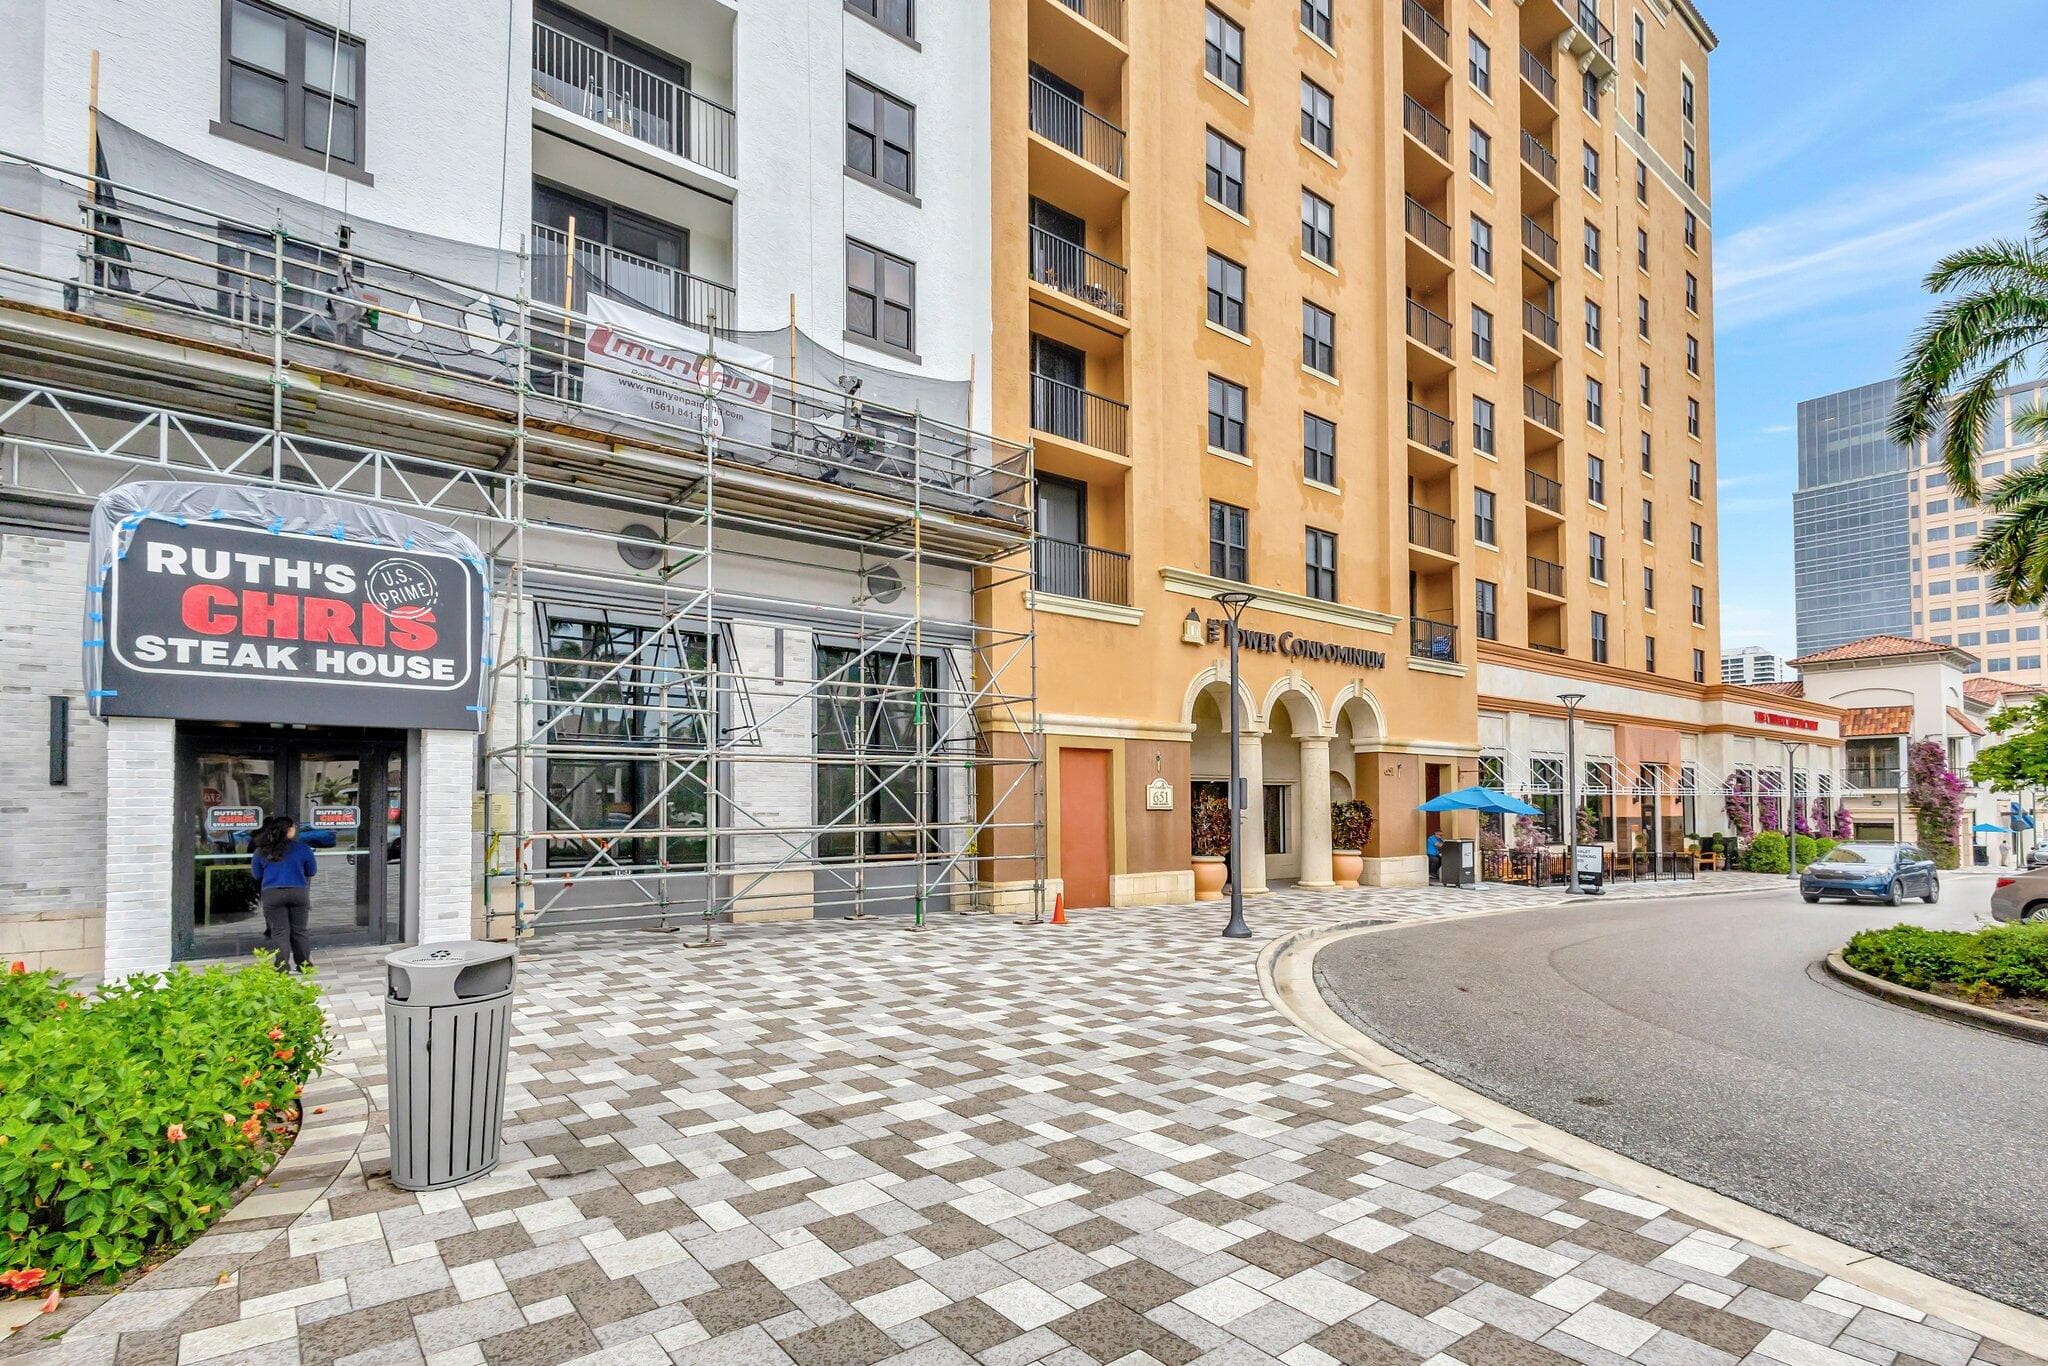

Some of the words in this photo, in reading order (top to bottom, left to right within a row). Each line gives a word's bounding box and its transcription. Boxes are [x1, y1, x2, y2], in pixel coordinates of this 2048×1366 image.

[618, 377, 744, 421] www.munyanpaintng.com
[146, 541, 356, 594] RUTH'S
[381, 568, 412, 587] U.S.
[379, 582, 429, 607] PRIME
[181, 584, 439, 651] CHRIS
[135, 635, 299, 671] STEAK
[316, 650, 455, 681] HOUSE
[1279, 631, 1386, 669] CONDOMINIUM
[1153, 791, 1168, 802] 651
